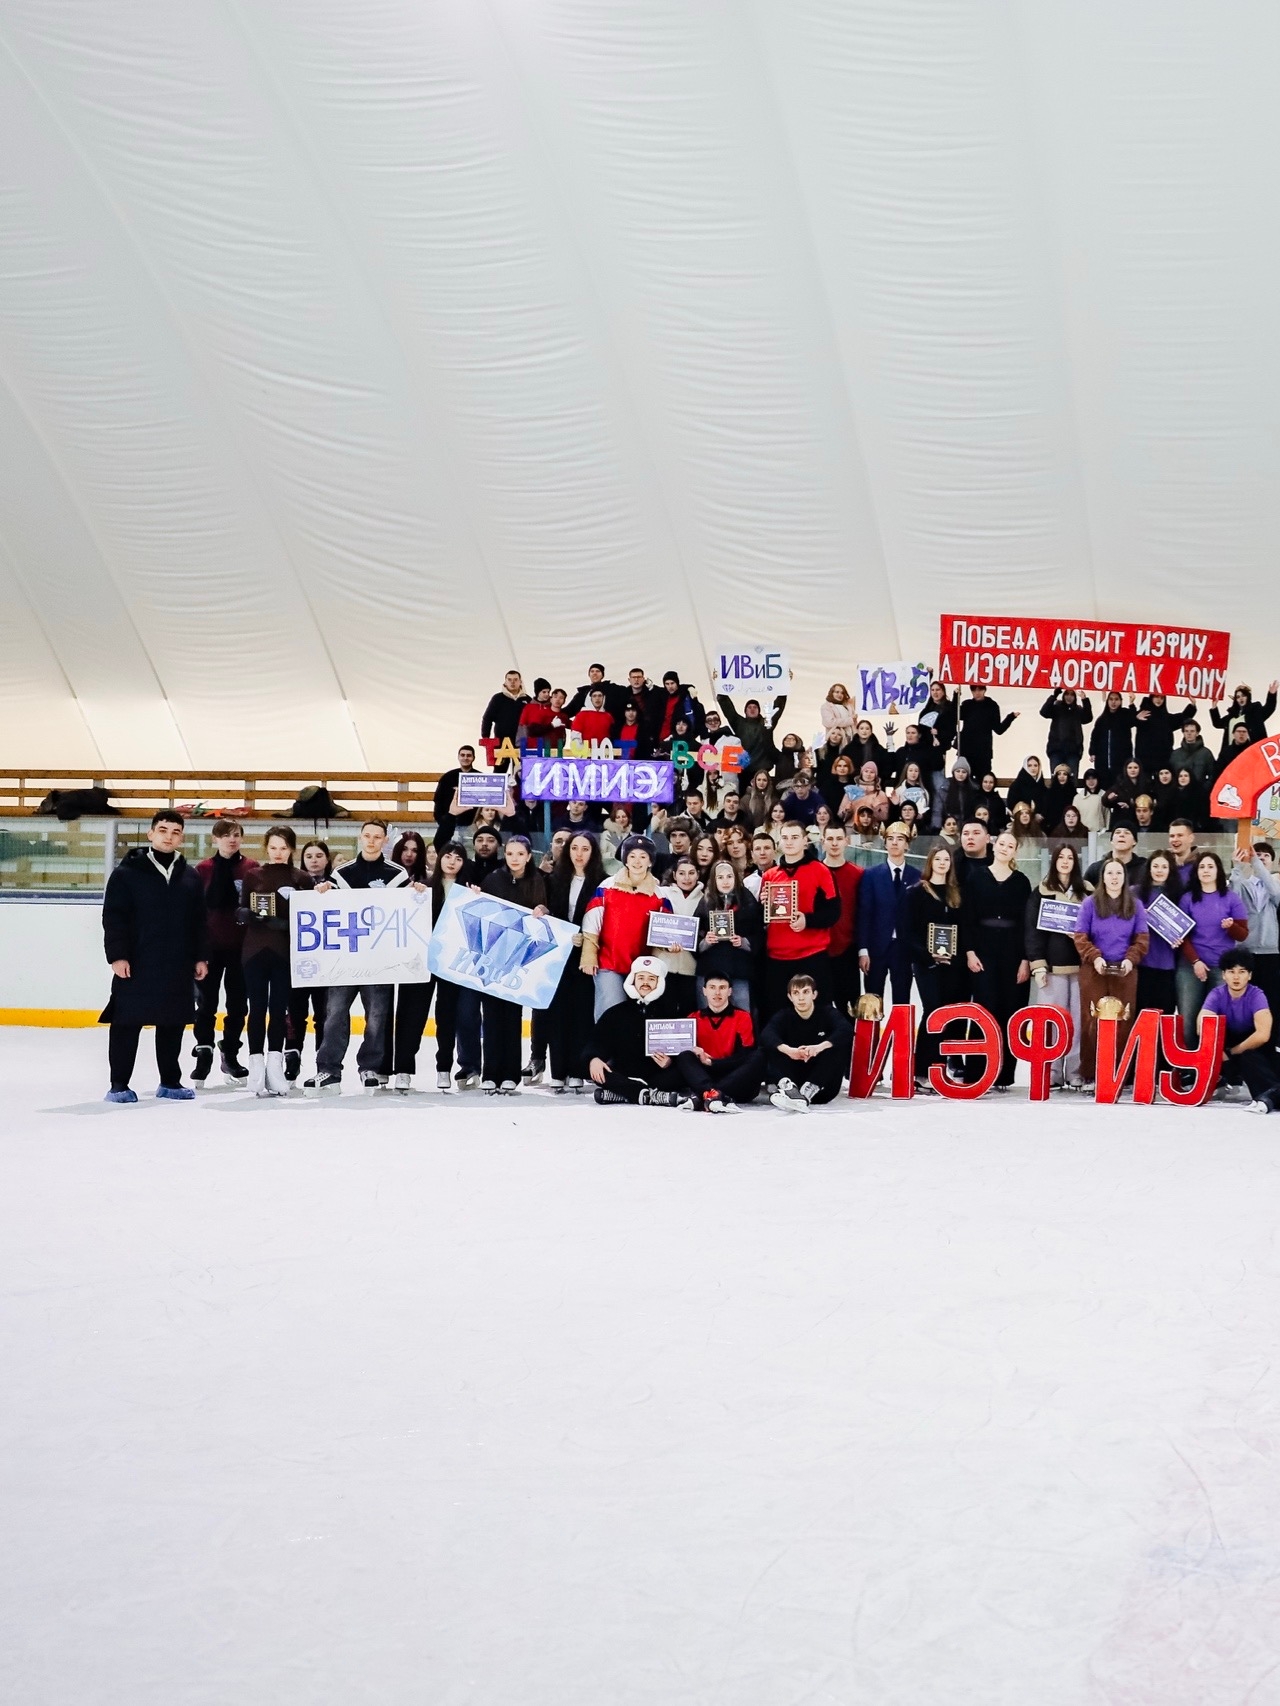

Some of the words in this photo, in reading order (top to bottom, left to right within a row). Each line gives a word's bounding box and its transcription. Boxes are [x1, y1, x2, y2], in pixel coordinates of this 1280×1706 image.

[952, 620, 1039, 650] ПОБЕДА
[1051, 628, 1125, 654] ЛЮБИТ
[1136, 630, 1213, 661] ИЭФИУ,
[720, 654, 783, 679] ИВиБ
[939, 654, 953, 682] А
[1150, 663, 1164, 693] К
[1175, 665, 1228, 700] ДОМУ
[671, 740, 745, 774] ВСЕ
[848, 1002, 1227, 1107] ИЭФИУ
